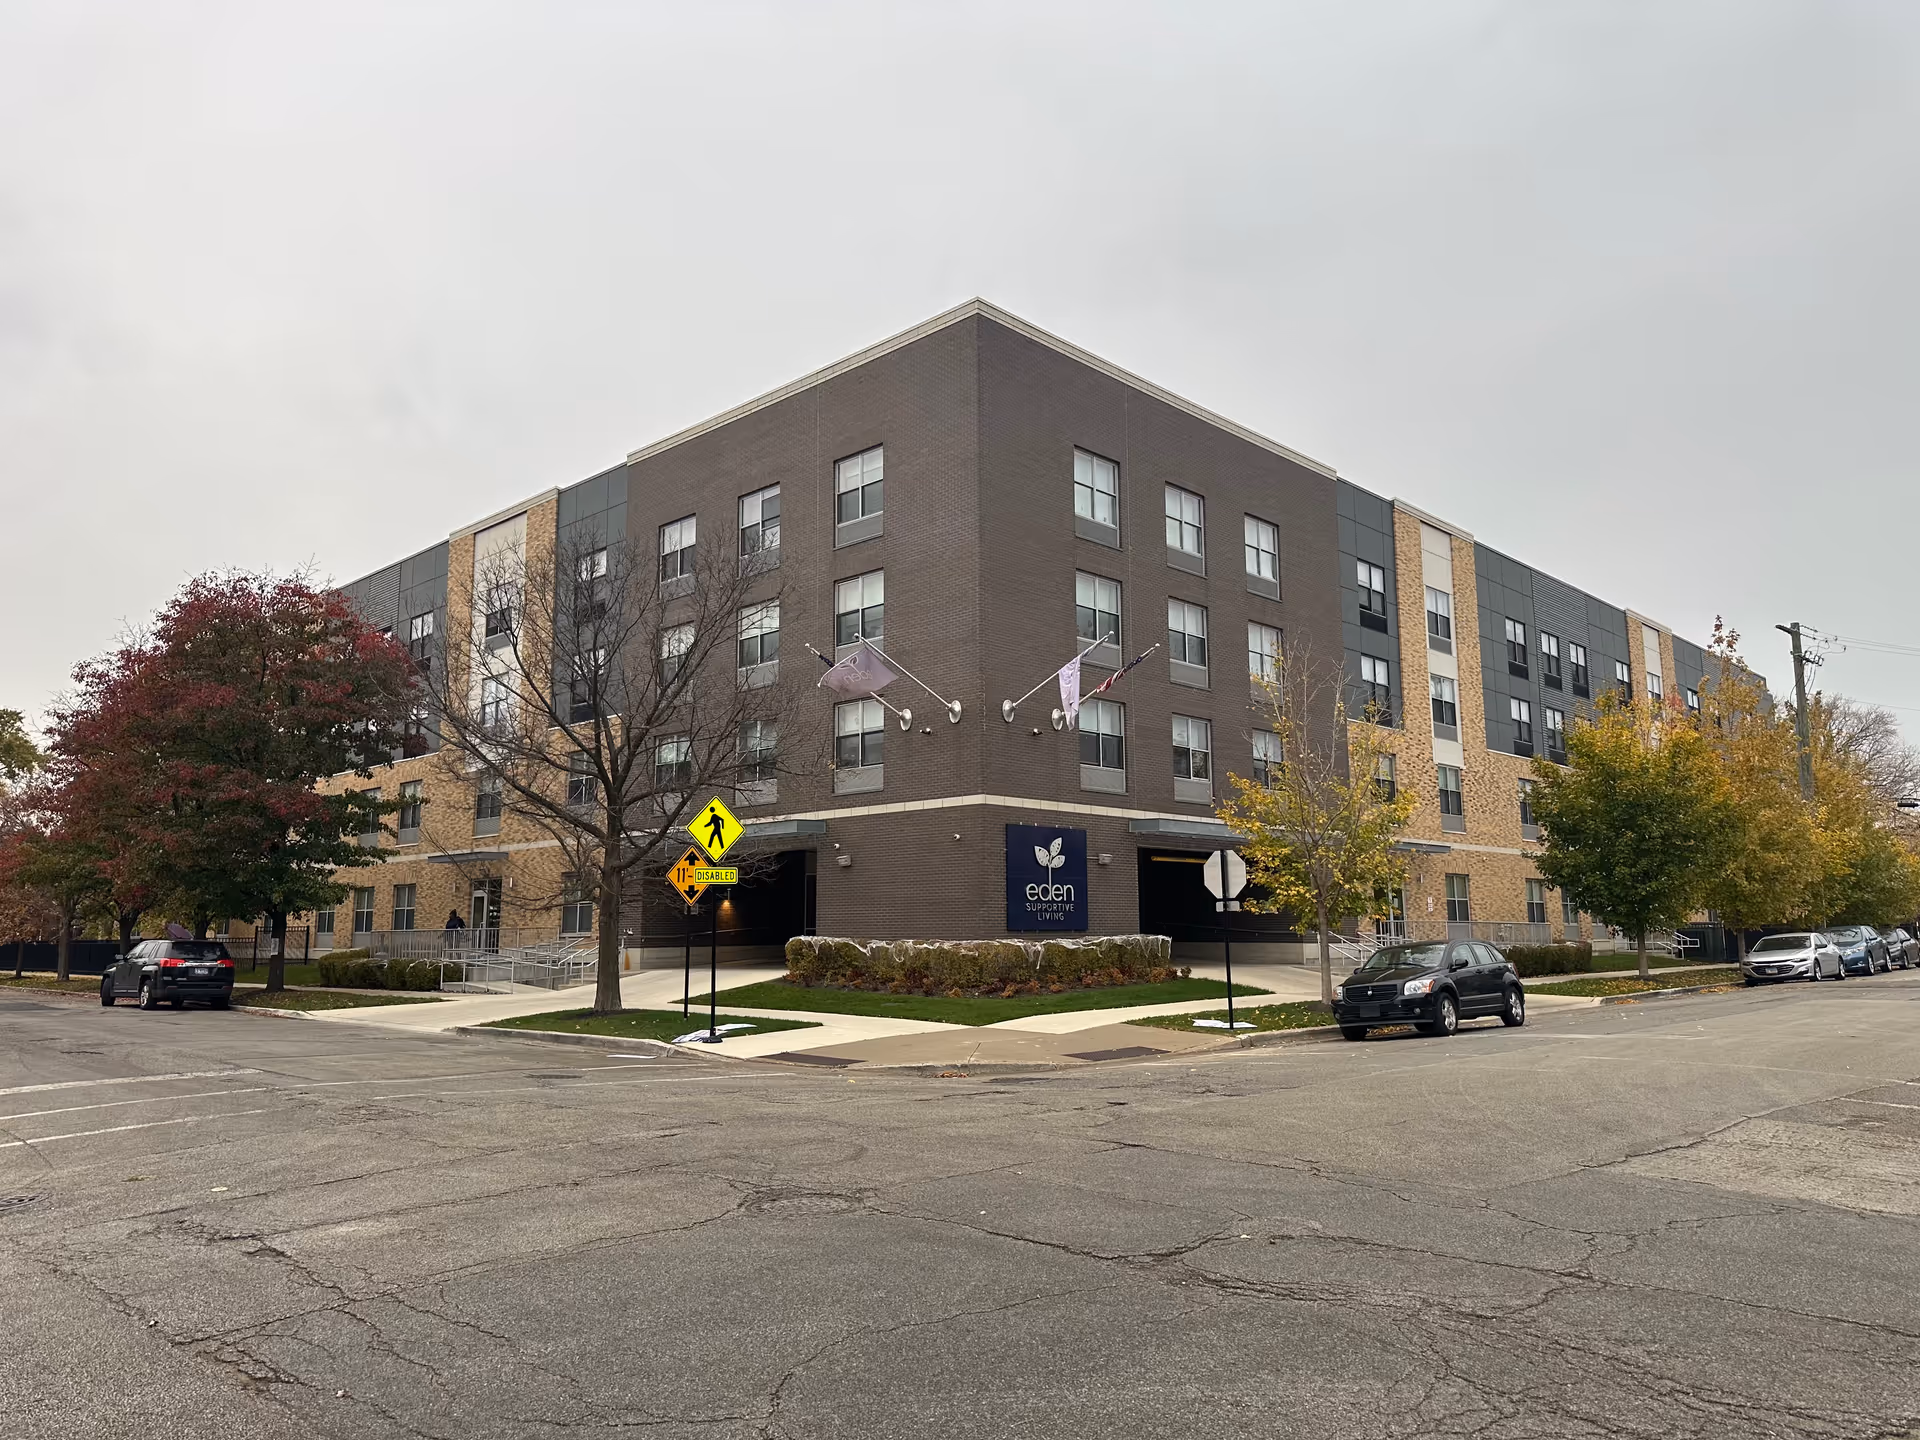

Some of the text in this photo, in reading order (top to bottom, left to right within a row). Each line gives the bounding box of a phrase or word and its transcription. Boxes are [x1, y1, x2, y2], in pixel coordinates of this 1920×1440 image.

[697, 871, 735, 881] DISABLED
[1025, 882, 1074, 901] eden
[1025, 902, 1075, 912] SUPPORTIVE
[1037, 912, 1064, 921] LIVING
